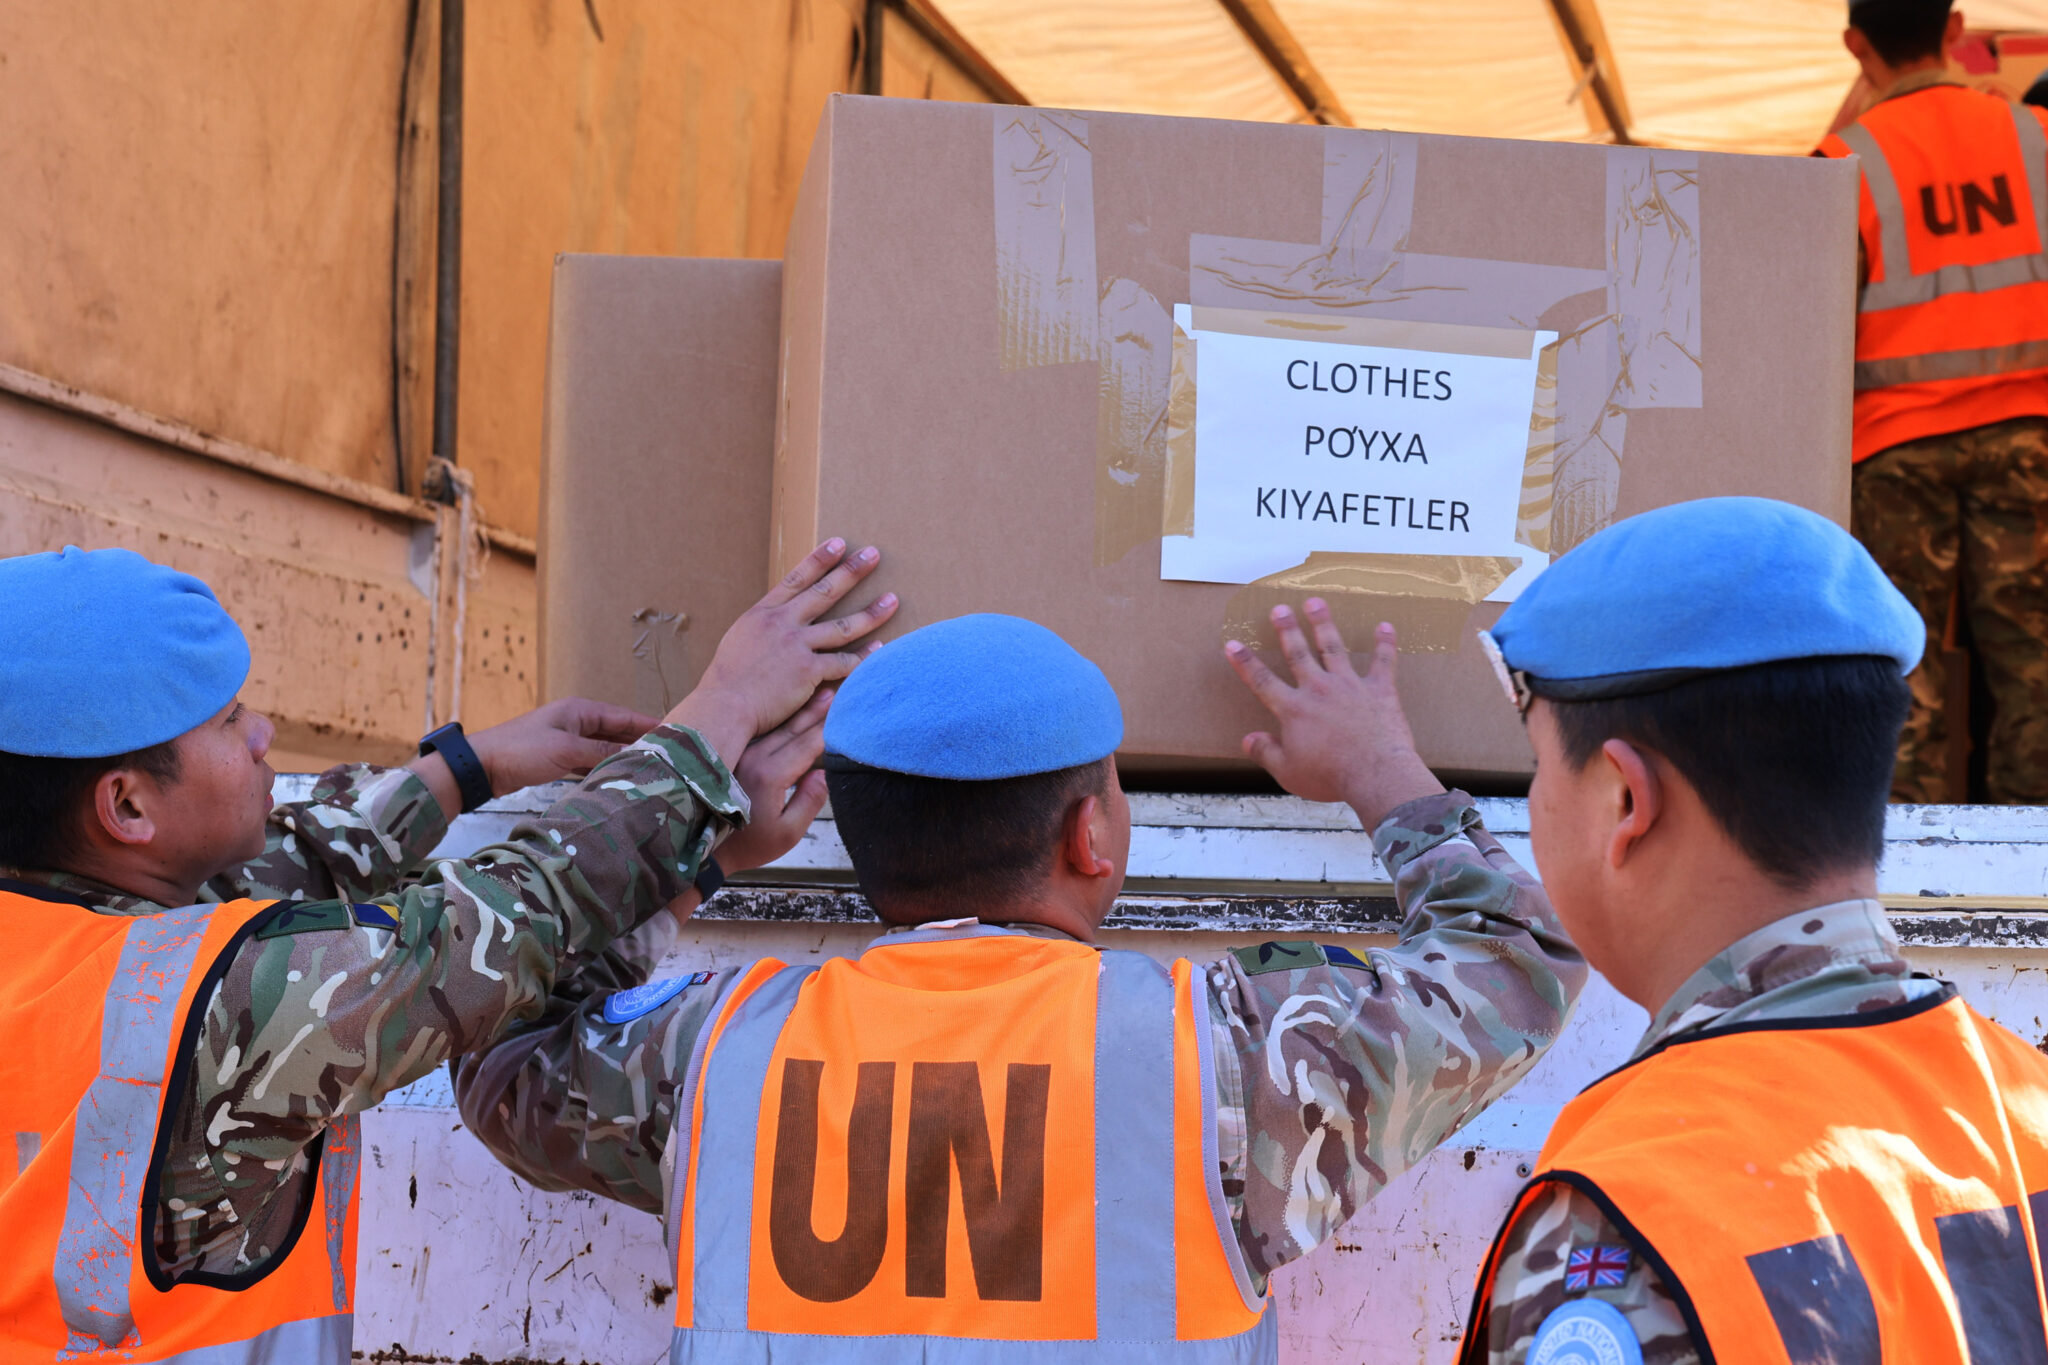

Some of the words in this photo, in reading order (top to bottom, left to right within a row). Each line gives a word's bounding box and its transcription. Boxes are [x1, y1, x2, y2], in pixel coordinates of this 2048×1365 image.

[1920, 174, 2018, 237] UN
[1286, 359, 1453, 401] CLOTHES
[1256, 486, 1470, 533] KIYAFETLER
[770, 1057, 1051, 1303] UN
